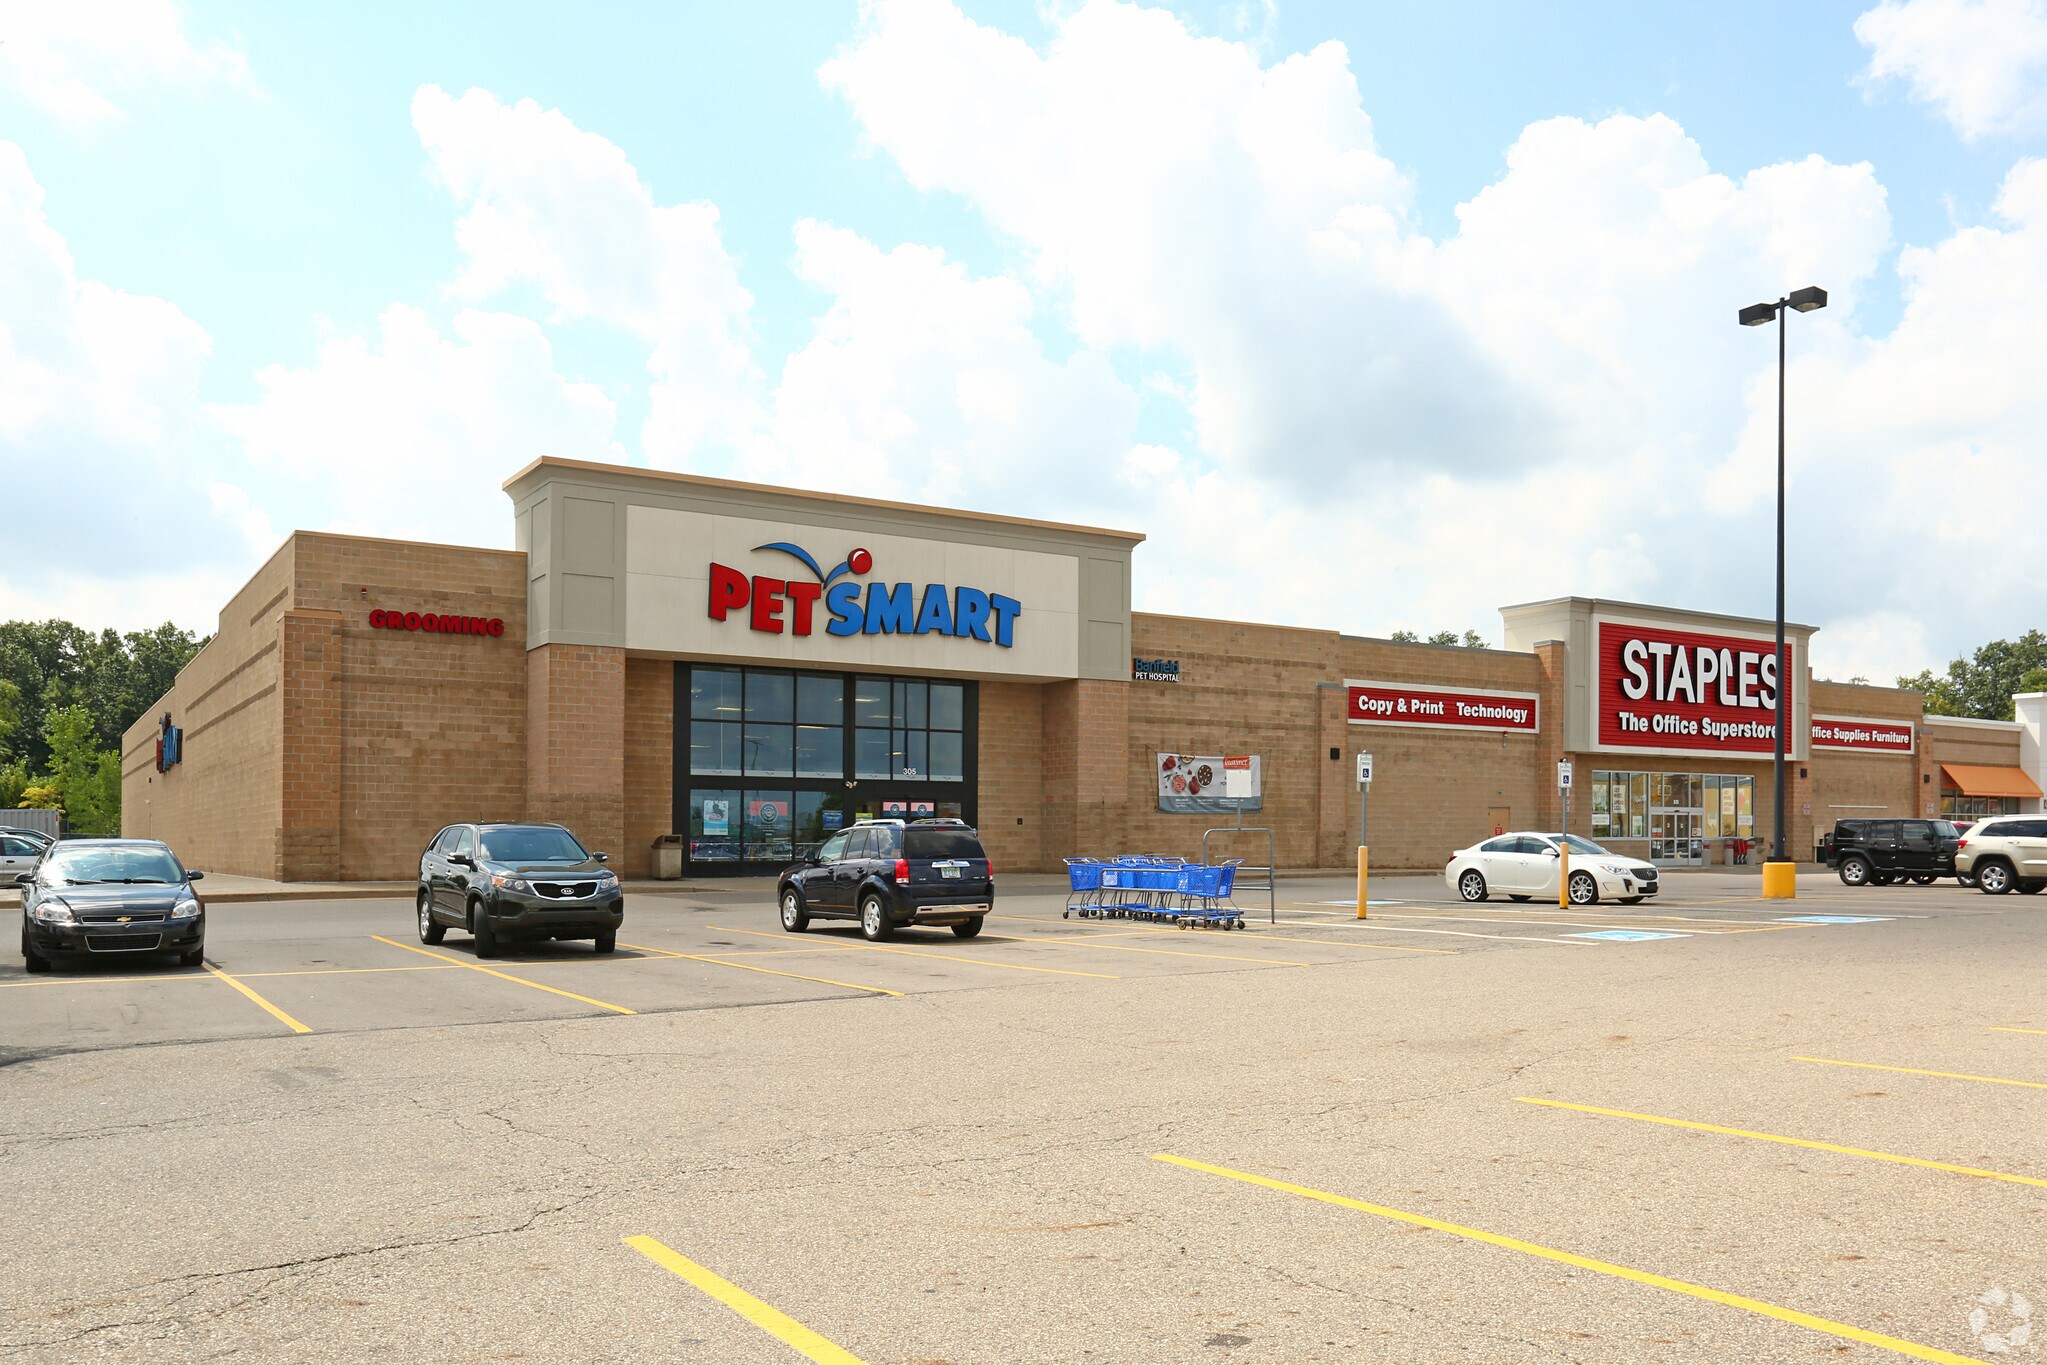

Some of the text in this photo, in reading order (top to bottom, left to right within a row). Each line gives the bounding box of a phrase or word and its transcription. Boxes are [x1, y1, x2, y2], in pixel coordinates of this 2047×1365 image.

[707, 562, 1022, 649] PETSMART
[369, 609, 505, 637] GROOMING
[1134, 658, 1180, 673] Banfield
[1135, 672, 1180, 682] PET HOSPITAL
[1621, 638, 1777, 710] STAPLES
[1358, 695, 1528, 723] Copy & Print Technology
[1619, 711, 1649, 732] The
[1652, 713, 1698, 736] Office
[1811, 726, 1910, 744] ffice Supplies Furniture
[903, 767, 917, 776] 305
